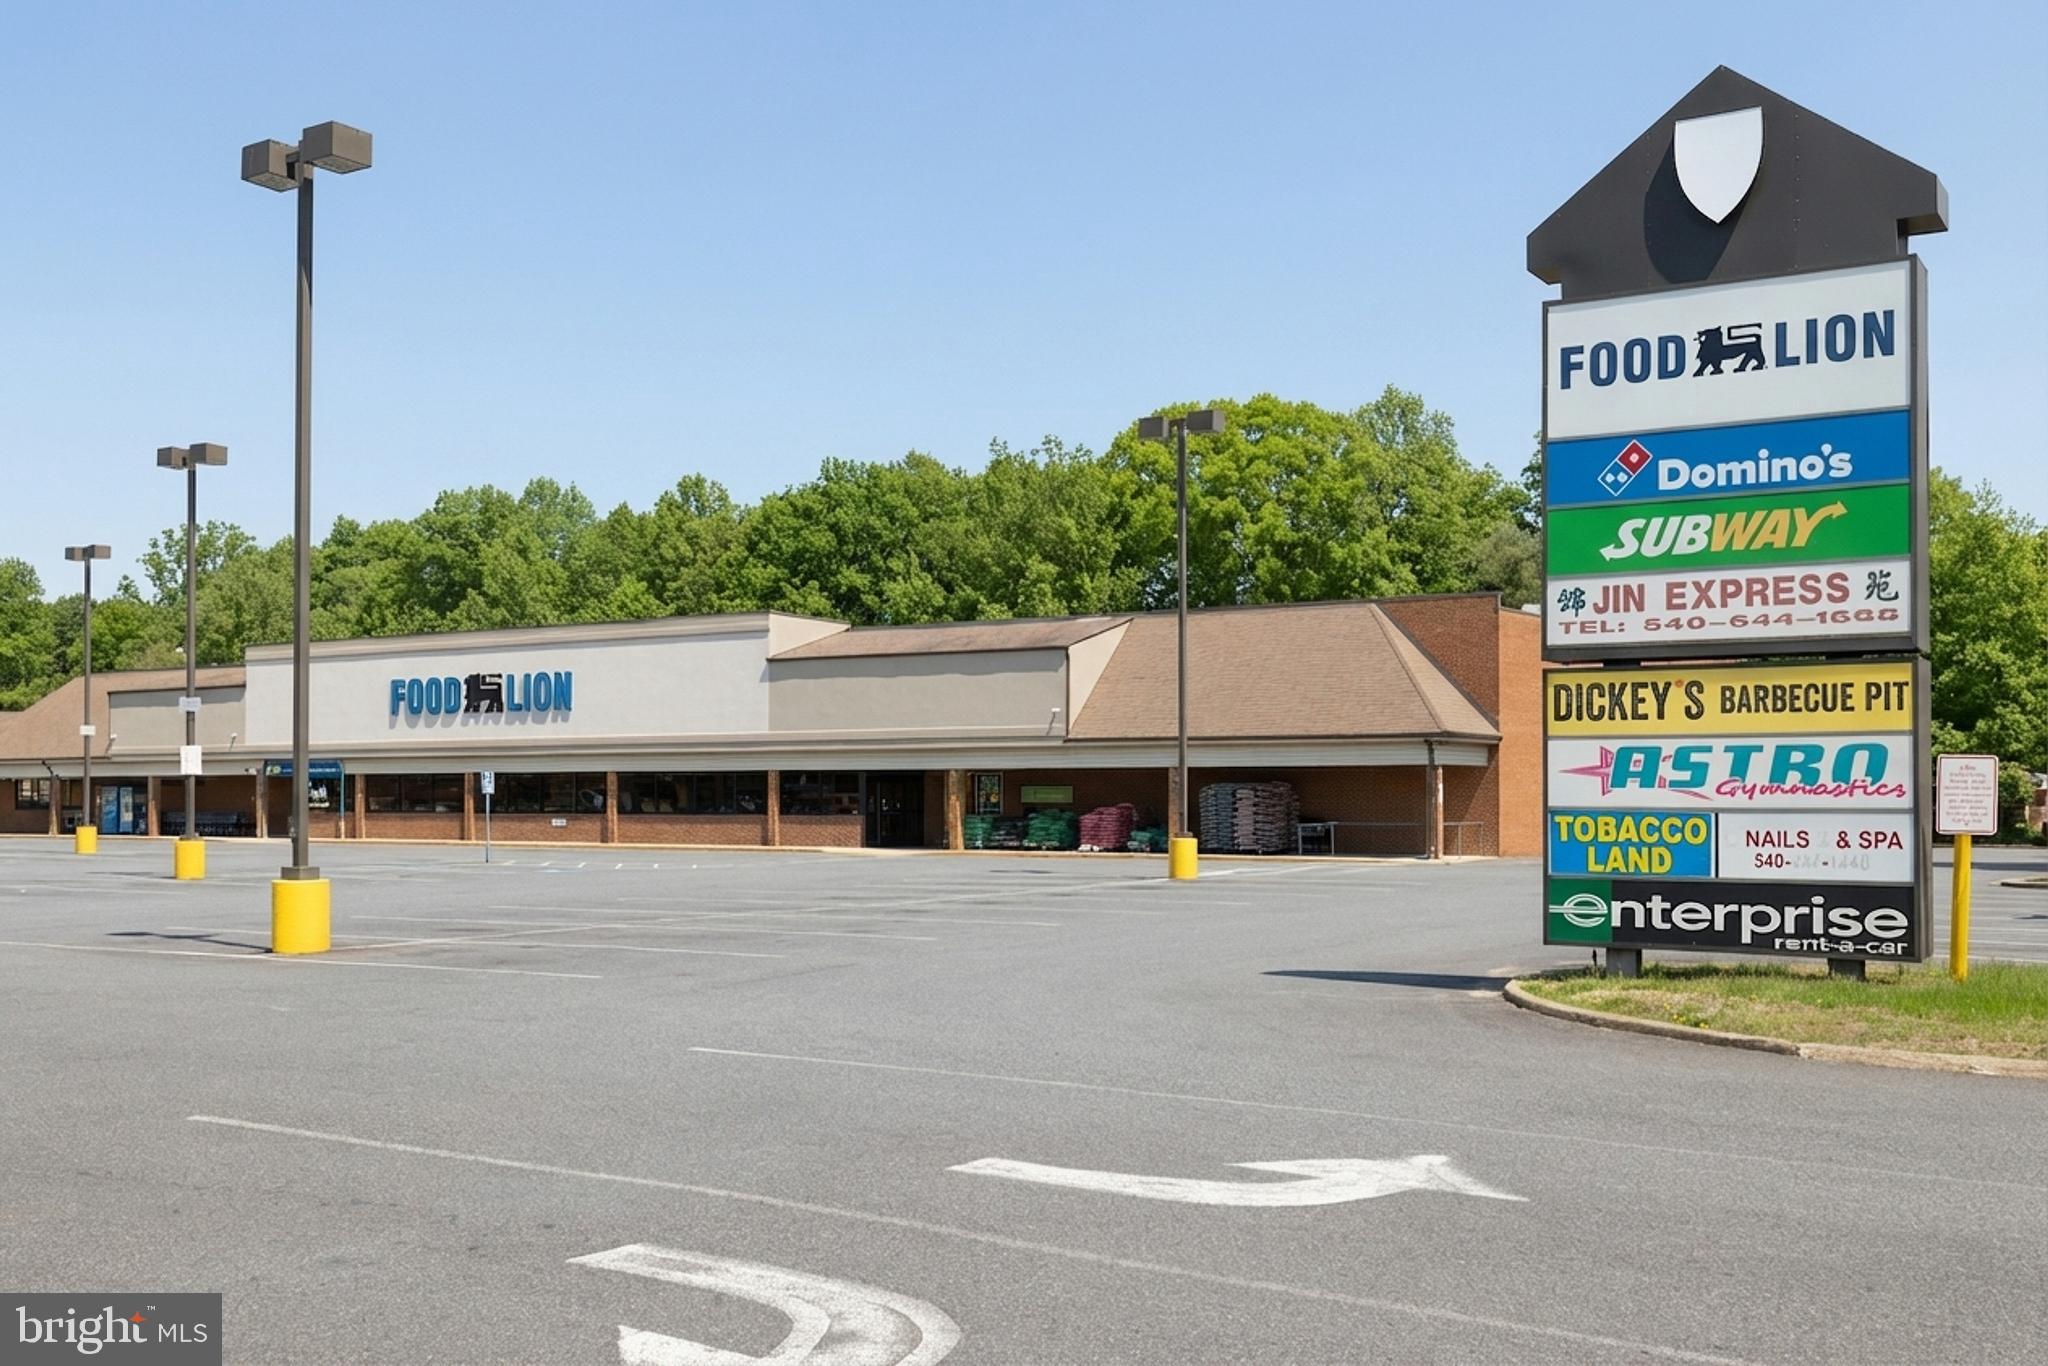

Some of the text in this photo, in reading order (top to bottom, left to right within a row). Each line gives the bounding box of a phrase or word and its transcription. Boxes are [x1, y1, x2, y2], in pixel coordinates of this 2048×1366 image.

[1559, 309, 1895, 390] FOOD LION
[1657, 443, 1853, 490] Domino's
[1600, 501, 1848, 562] SUBWAY
[1592, 571, 1851, 615] JIN EXPRESS
[1558, 619, 1626, 635] TEL:
[390, 671, 573, 717] FOOD LION
[1553, 679, 1910, 722] DICKEY'S BARBECUE PIT
[1610, 742, 1889, 789] ASTRO
[1715, 778, 1907, 800] Gymnastics
[1553, 814, 1708, 844] TOBACCO
[1745, 830, 1904, 850] NAILS & SPA
[1586, 845, 1673, 875] LAND
[1550, 893, 1909, 944] enterprise
[1773, 936, 1909, 956] rent-a-car
